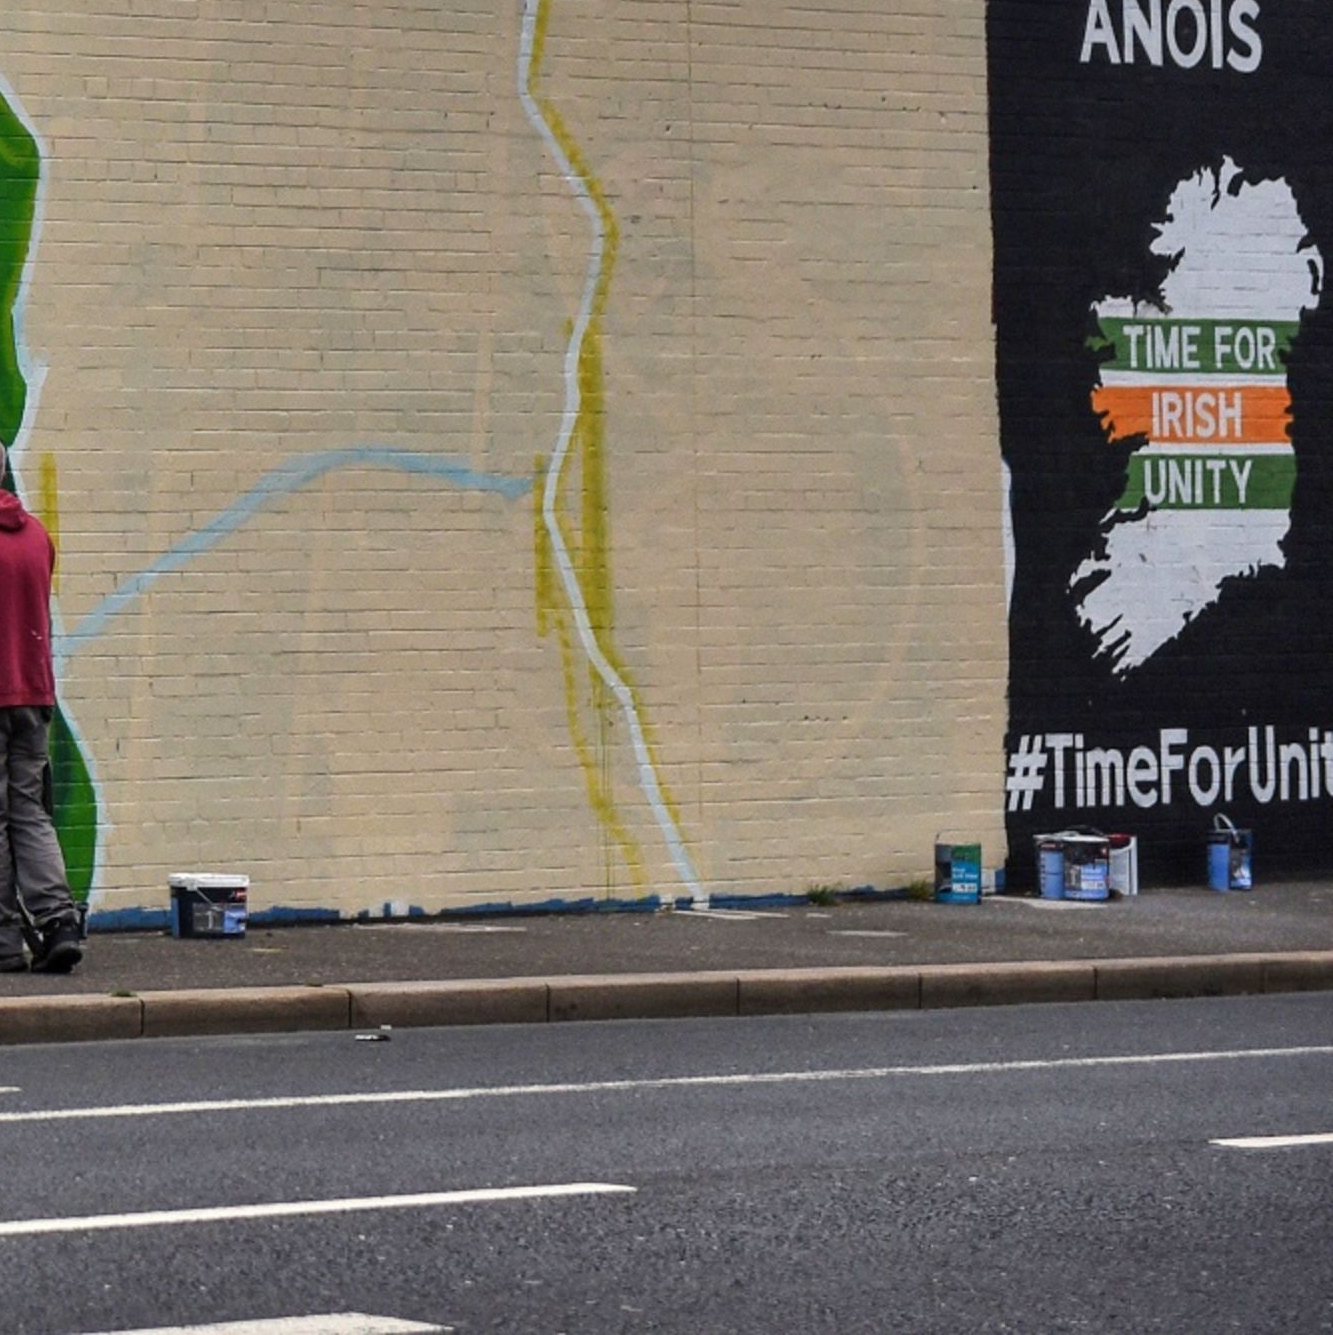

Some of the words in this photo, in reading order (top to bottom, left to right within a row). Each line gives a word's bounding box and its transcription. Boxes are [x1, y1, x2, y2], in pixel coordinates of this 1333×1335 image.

[1123, 325, 1201, 369] TIME
[1214, 326, 1276, 370] FOR
[1151, 391, 1243, 438] IRISH
[1144, 459, 1253, 505] UNITY
